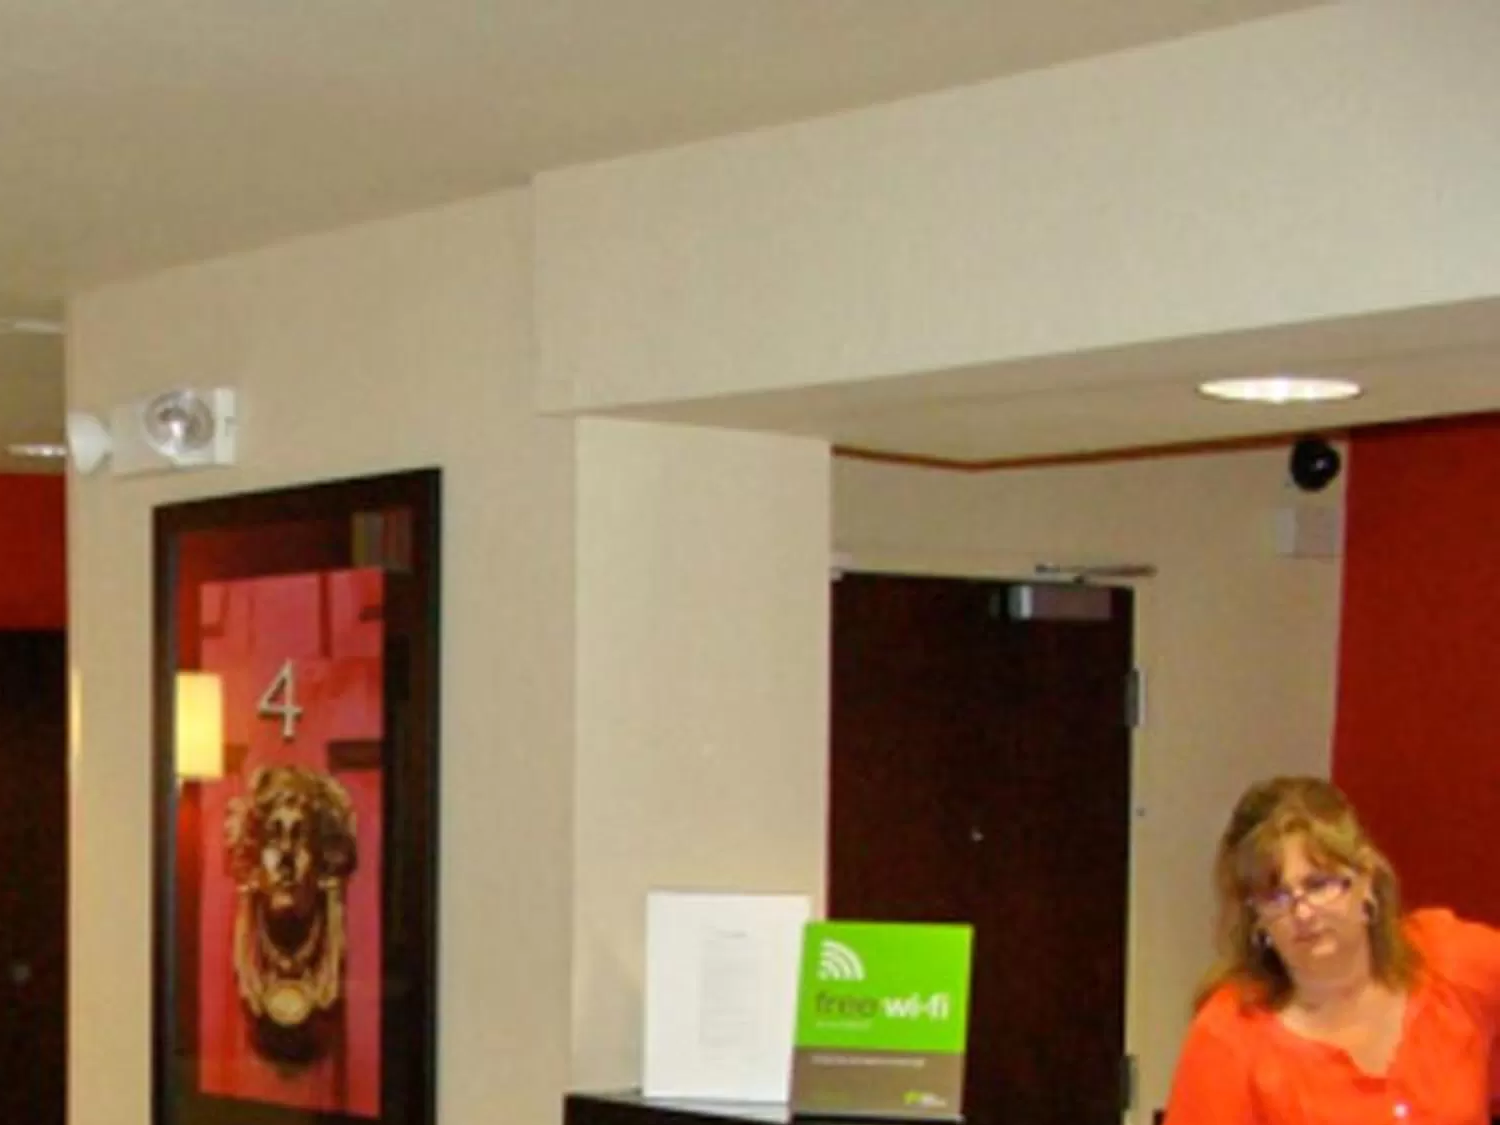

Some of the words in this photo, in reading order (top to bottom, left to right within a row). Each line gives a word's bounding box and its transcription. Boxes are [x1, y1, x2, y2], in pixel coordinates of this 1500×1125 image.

[257, 658, 303, 737] 4
[817, 989, 876, 1018] free
[884, 993, 948, 1019] wi-fi
